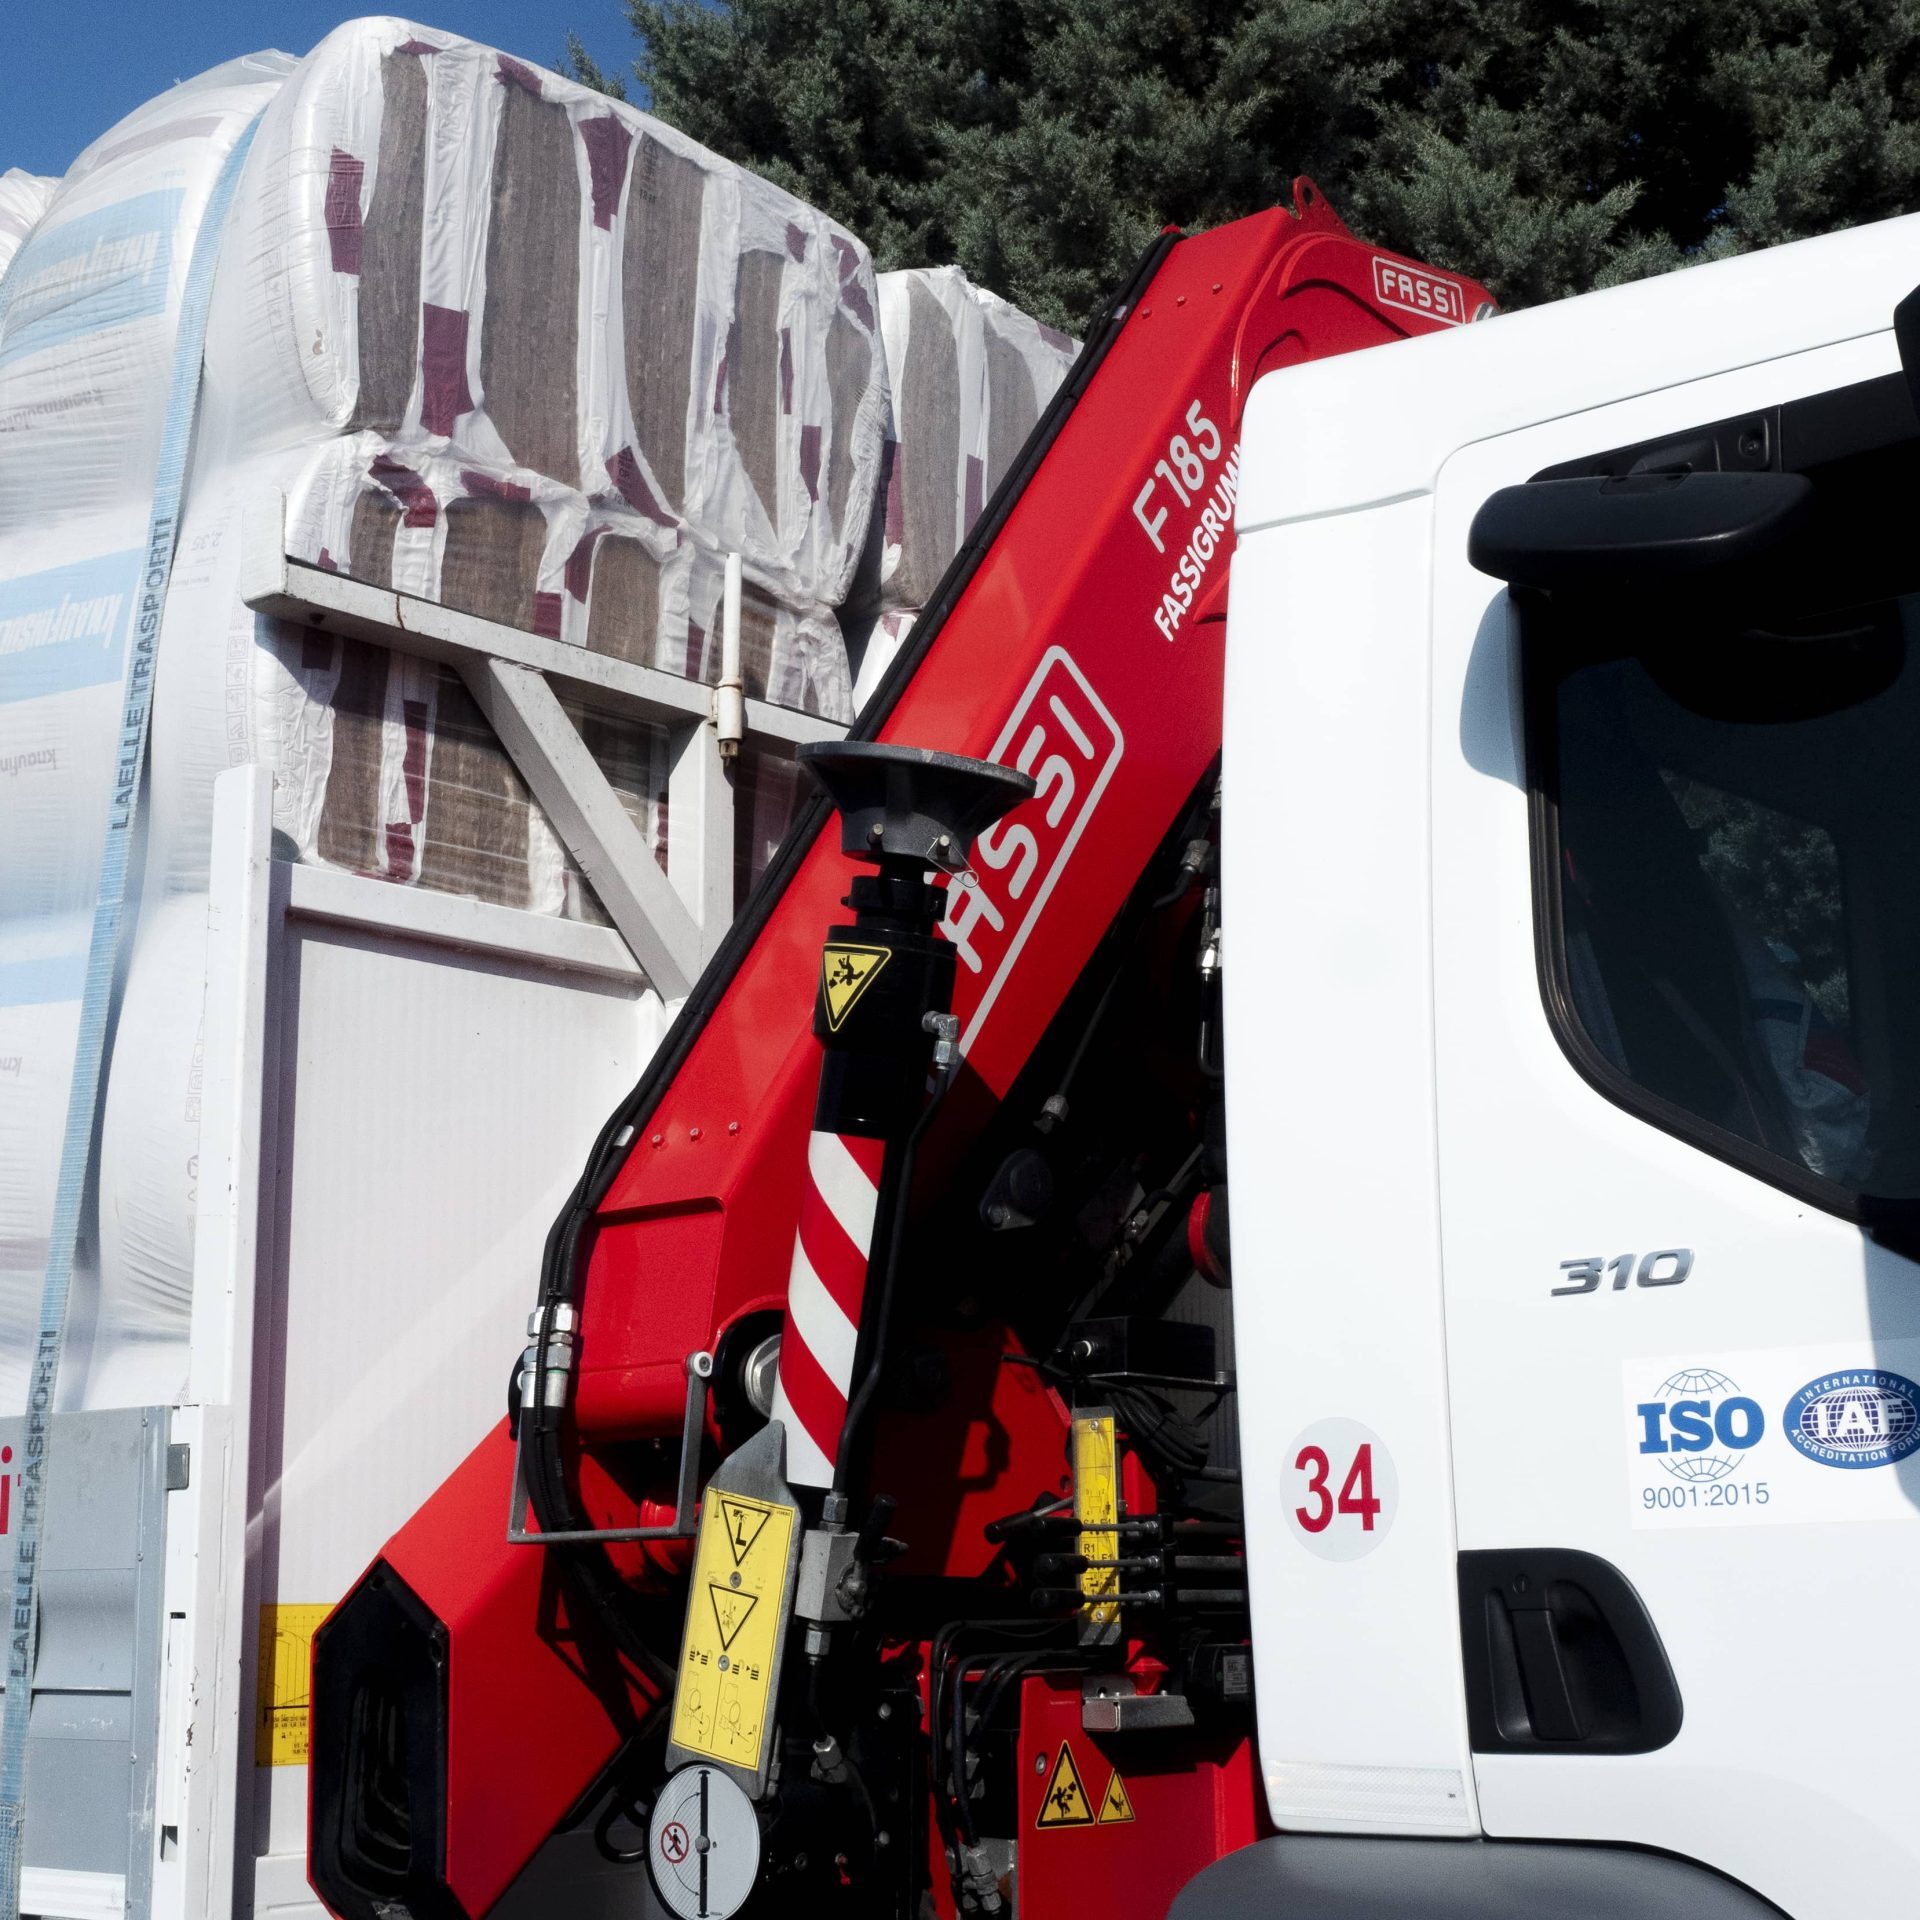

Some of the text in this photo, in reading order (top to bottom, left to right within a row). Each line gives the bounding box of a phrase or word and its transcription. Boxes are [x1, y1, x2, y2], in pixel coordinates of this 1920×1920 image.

[1382, 268, 1457, 317] FASSI
[1133, 399, 1221, 553] F185
[1153, 443, 1240, 642] FASSIGRUM
[112, 516, 172, 830] LAELLE TRASPORTI
[930, 694, 1095, 973] ASSI
[1551, 1249, 1695, 1297] 310
[1800, 1374, 1914, 1404] INTERNATIONAL
[1816, 1398, 1903, 1438] IAF
[1637, 1396, 1765, 1454] ISO
[1791, 1428, 1888, 1463] ACCREDITATION
[1295, 1443, 1381, 1533] 34
[1643, 1482, 1770, 1509] 9001:2015
[11, 1541, 36, 1678] LAELLE
